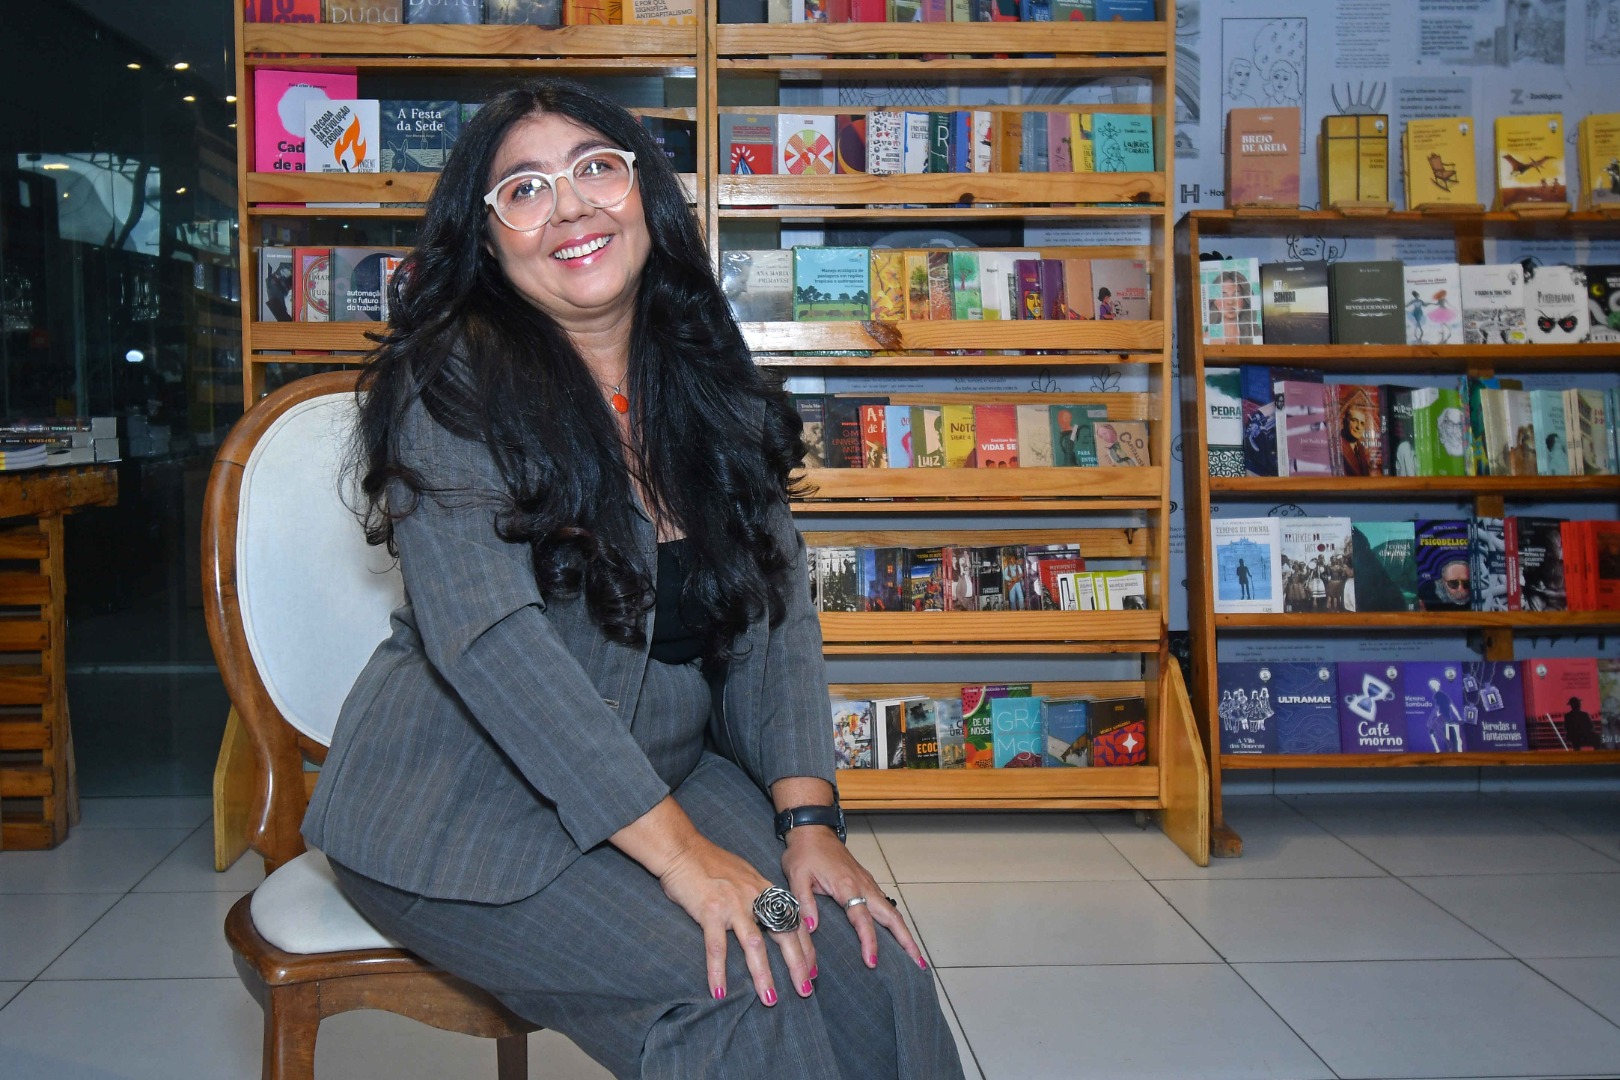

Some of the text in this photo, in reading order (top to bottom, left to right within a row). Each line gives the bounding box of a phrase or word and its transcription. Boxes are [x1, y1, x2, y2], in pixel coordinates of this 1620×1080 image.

[636, 9, 692, 19] ANTICAPITALISMO
[1510, 89, 1563, 105] Z Zoológico
[398, 108, 442, 119] A Festa
[313, 110, 334, 131] DÉCADA
[316, 105, 351, 142] DA REVOLUÇÃO
[397, 120, 443, 132] da Sede
[322, 125, 345, 149] PERDIDA
[1242, 134, 1273, 143] BREJO
[1242, 143, 1288, 152] DE AREIA
[273, 158, 291, 171] de
[1181, 184, 1200, 203] H
[1210, 189, 1225, 197] Hos
[1211, 405, 1241, 416] PEDRA
[918, 454, 941, 468] LUIZ
[1216, 526, 1239, 534] TEMPOS
[1248, 525, 1270, 533] JORNAL
[1278, 696, 1331, 704] ULTRAMAR
[973, 718, 982, 727] DE
[1481, 721, 1510, 731] Veredas
[970, 726, 992, 735] NOSS
[1358, 721, 1391, 737] Café
[1359, 737, 1403, 746] morno
[1482, 731, 1522, 742] Fantasmas
